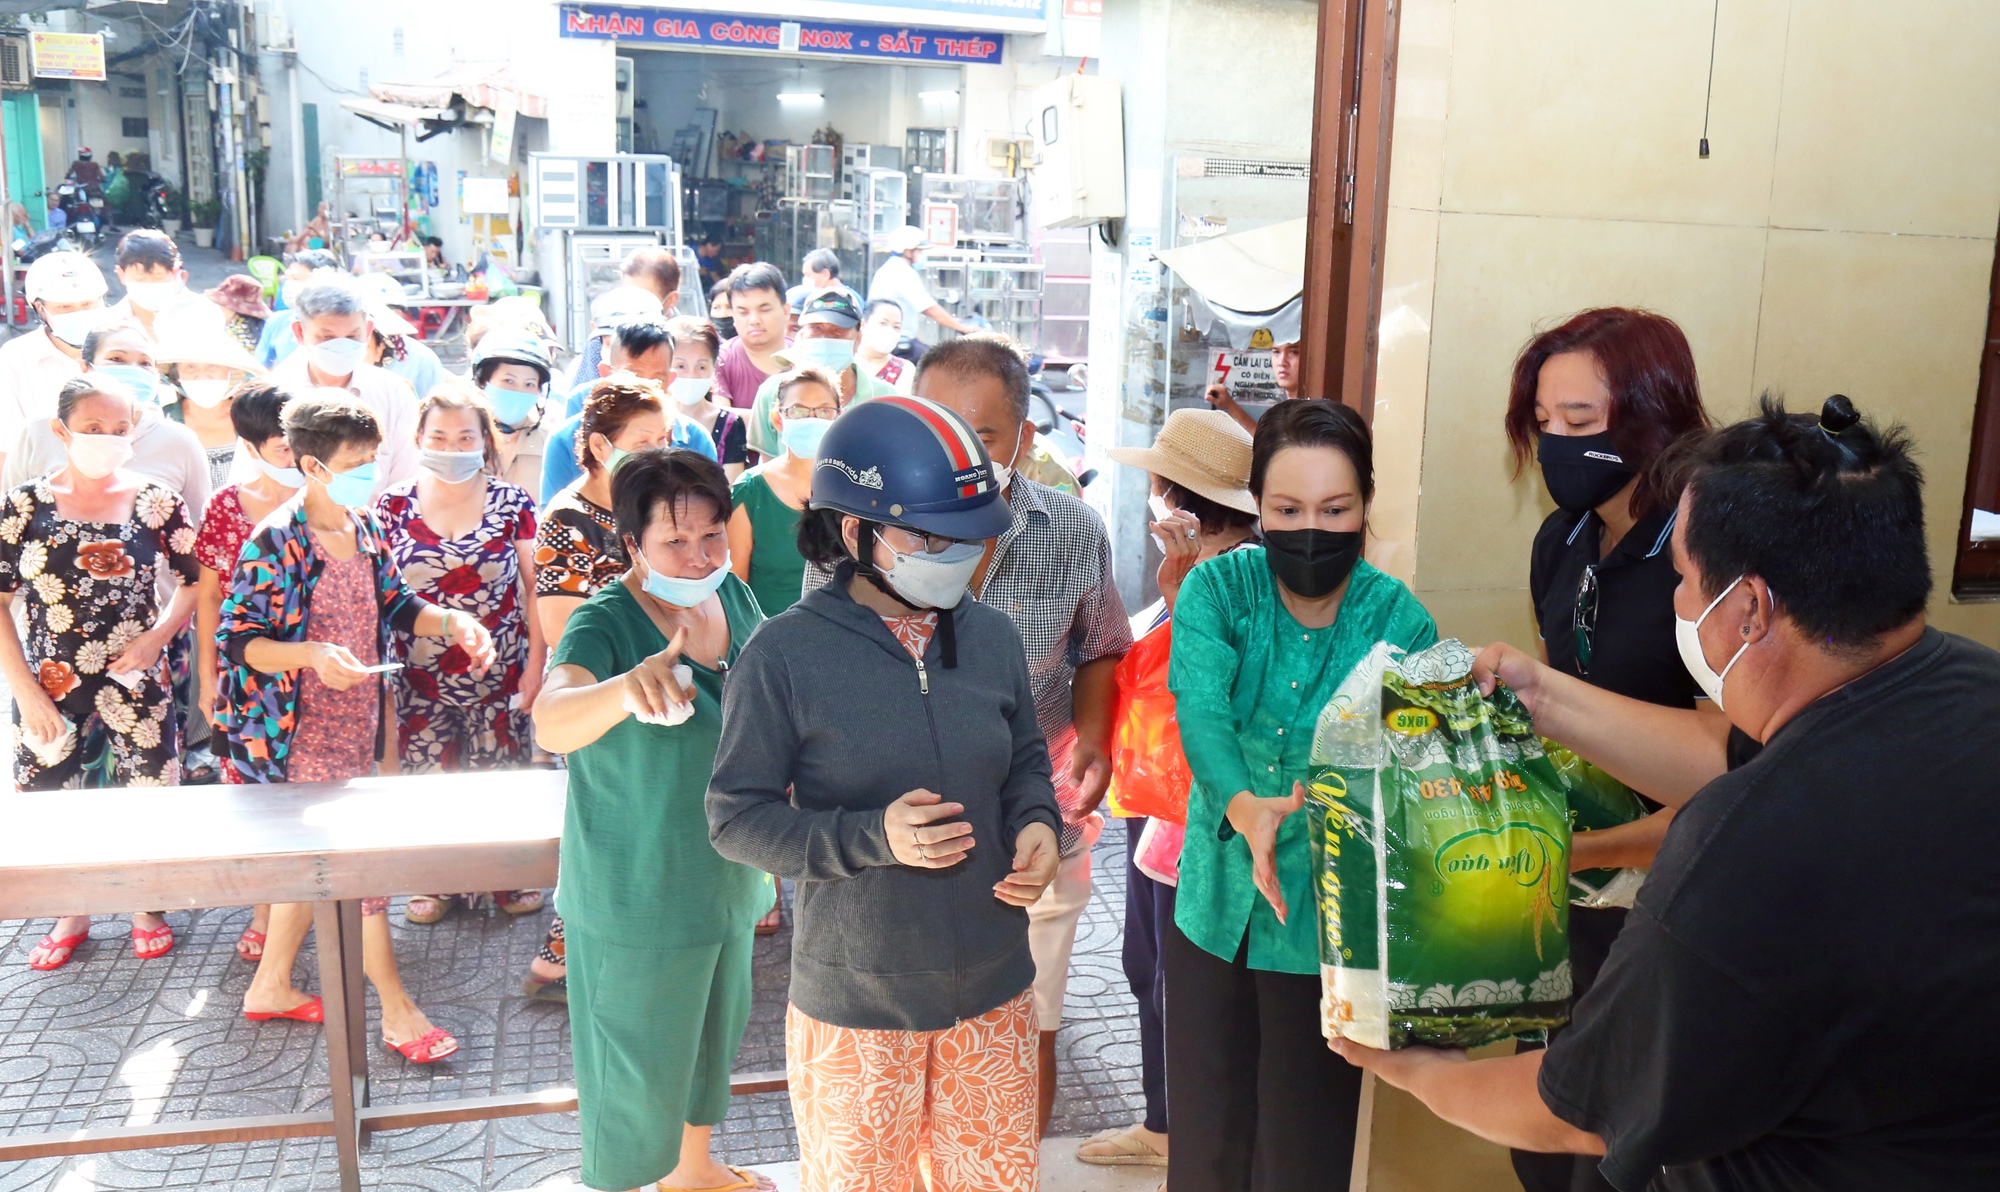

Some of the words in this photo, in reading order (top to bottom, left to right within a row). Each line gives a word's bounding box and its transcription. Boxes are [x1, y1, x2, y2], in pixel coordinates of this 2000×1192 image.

[567, 11, 644, 39] NHẬN
[653, 18, 701, 39] GIA
[710, 20, 780, 44] CÔNG
[800, 29, 853, 49] NOX
[878, 28, 926, 54] SẮT
[935, 37, 997, 58] THÉP
[1262, 166, 1304, 178] Technology
[845, 466, 859, 481] ride
[1424, 807, 1458, 820] ngon
[1446, 852, 1491, 874] gạo
[1320, 869, 1343, 948] gạo
